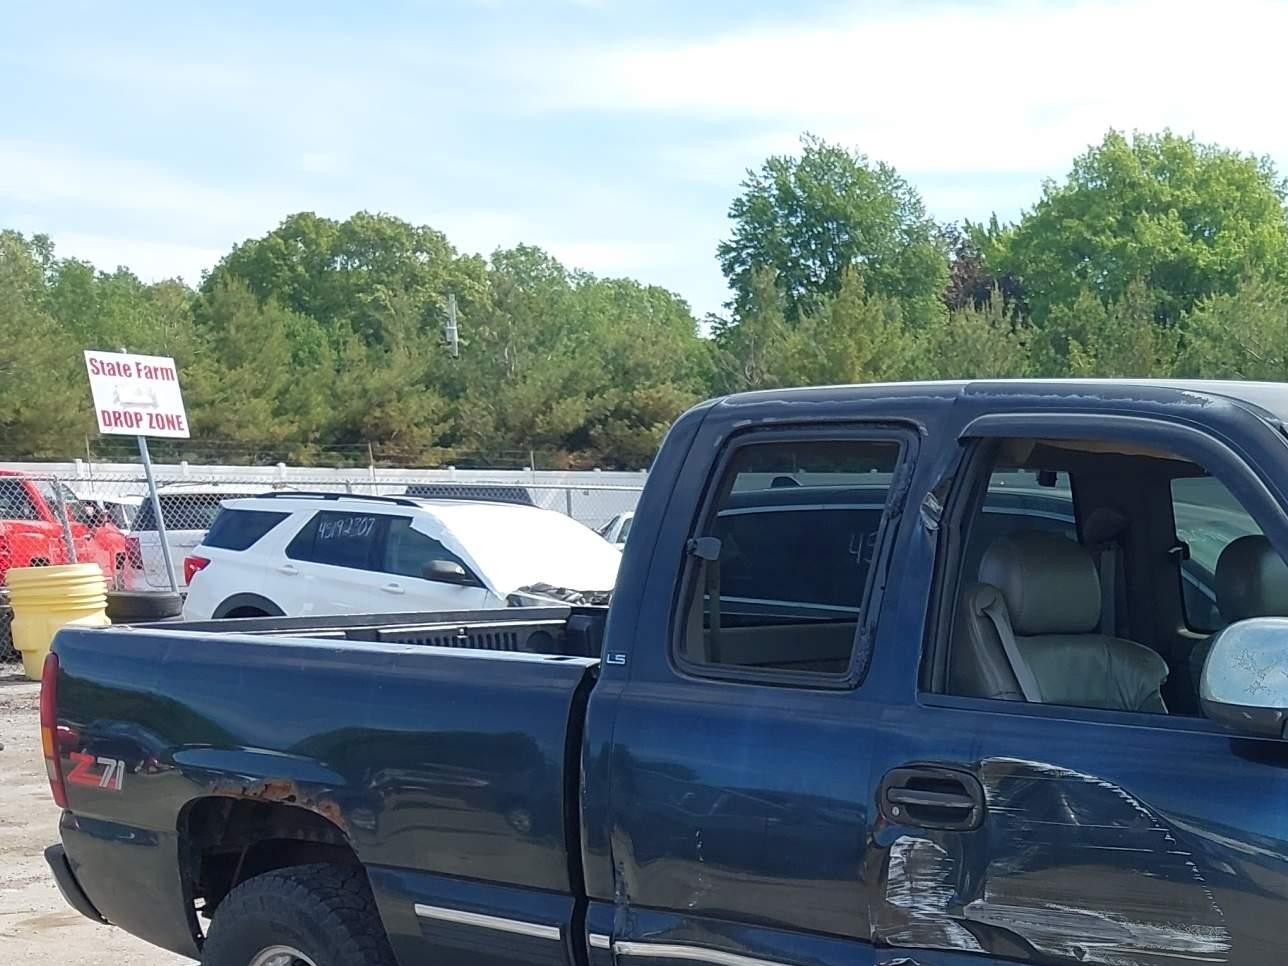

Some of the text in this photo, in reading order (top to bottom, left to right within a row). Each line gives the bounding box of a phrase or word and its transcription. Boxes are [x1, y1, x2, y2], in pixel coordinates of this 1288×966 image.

[89, 357, 175, 381] State Farm
[101, 409, 185, 431] DROP ZONE
[606, 653, 626, 665] LS
[67, 751, 125, 791] Z71
